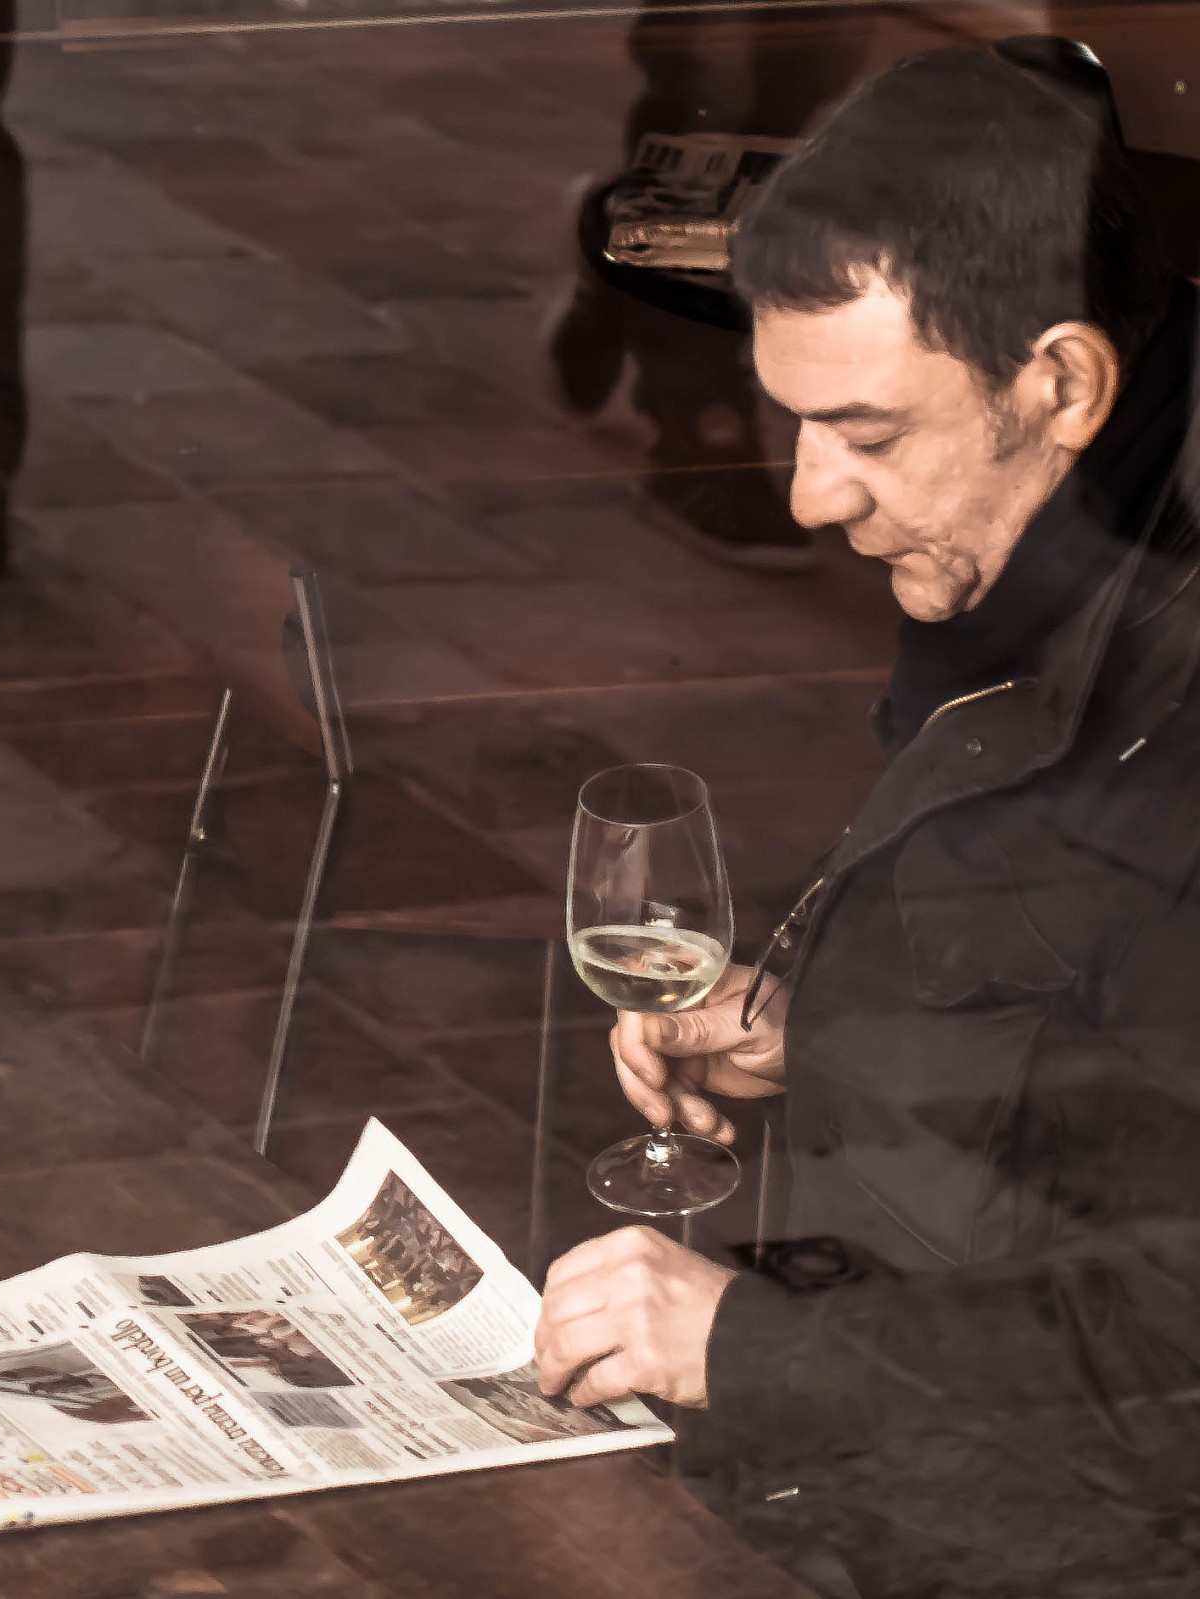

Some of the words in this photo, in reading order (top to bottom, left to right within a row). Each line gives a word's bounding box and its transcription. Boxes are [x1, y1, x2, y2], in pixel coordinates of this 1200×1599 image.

[111, 1318, 174, 1374] bordello
[163, 1366, 191, 1387] un
[180, 1384, 224, 1406] per
